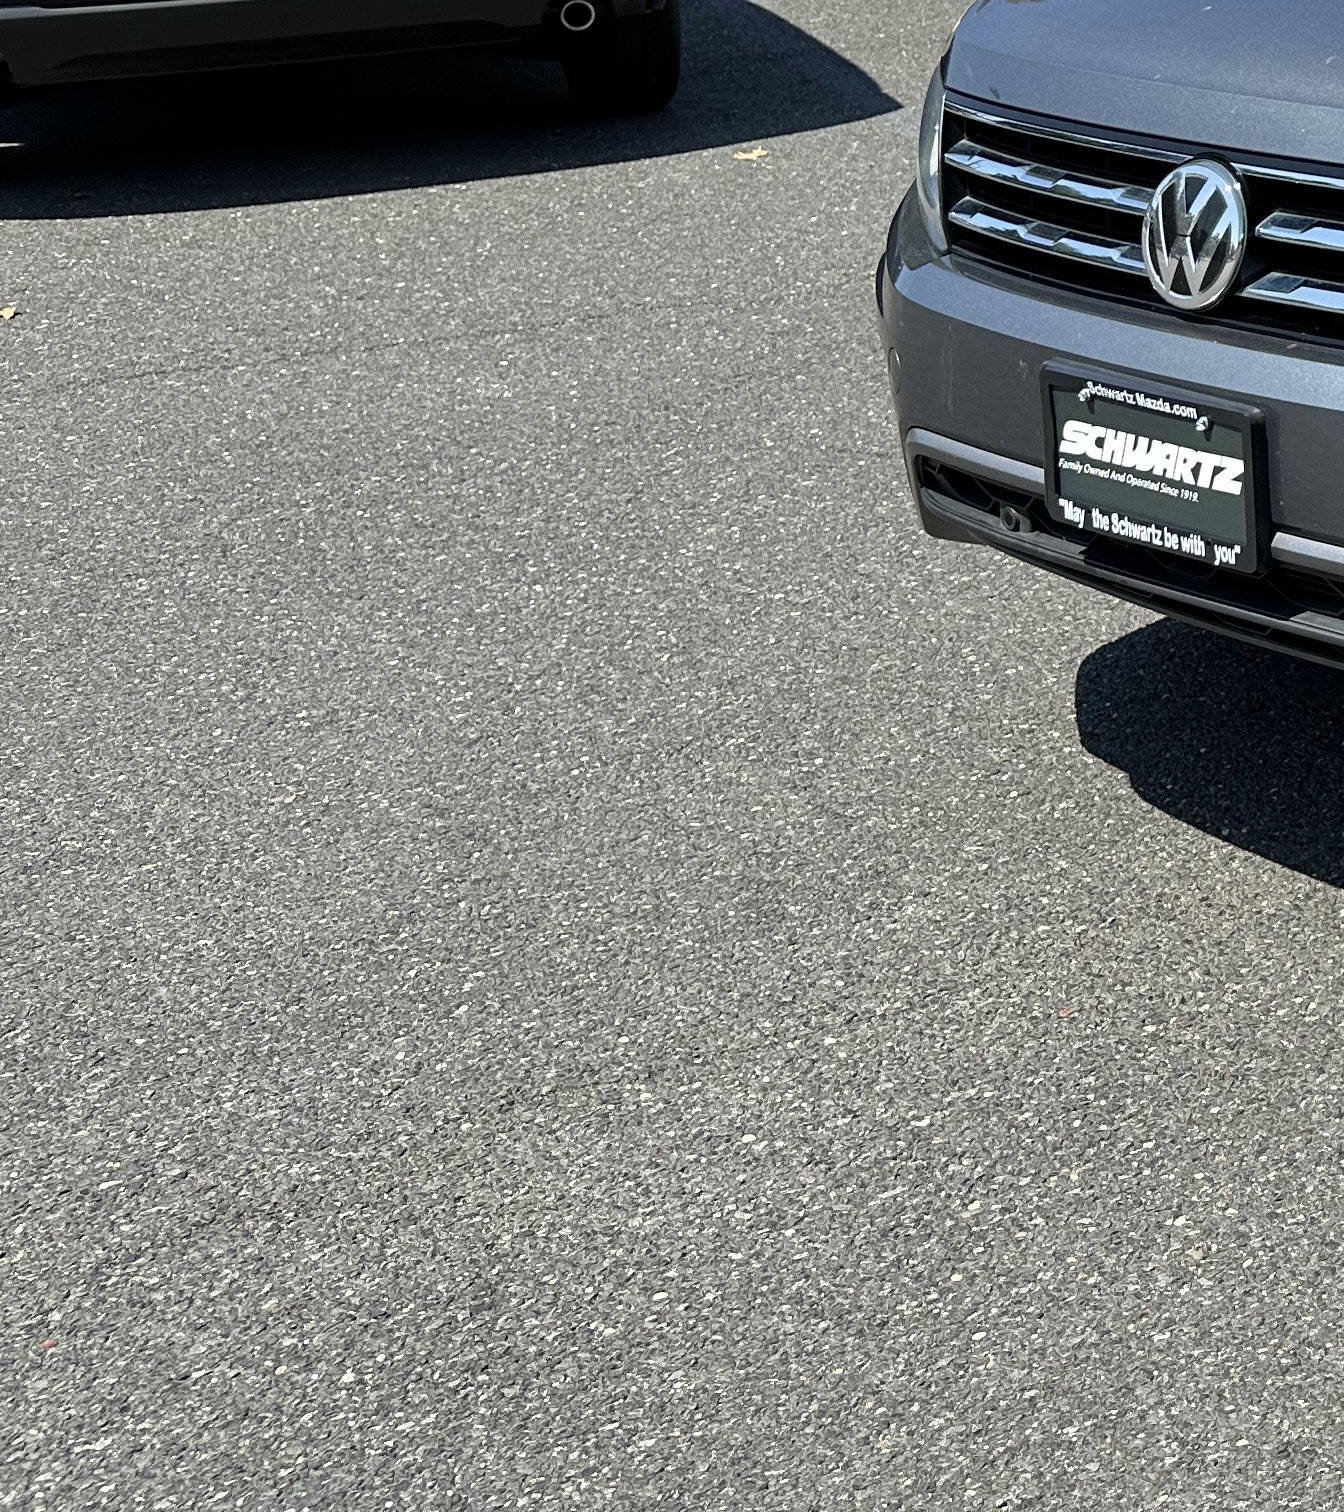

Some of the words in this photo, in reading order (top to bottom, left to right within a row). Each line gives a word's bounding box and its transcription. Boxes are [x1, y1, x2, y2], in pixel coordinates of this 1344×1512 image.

[1086, 381, 1136, 406] Schwartz
[1135, 393, 1198, 420] Mazda.com
[1058, 457, 1083, 474] Family
[1083, 463, 1110, 479] Owned
[1110, 469, 1126, 483] And
[1126, 473, 1160, 492] Operated
[1160, 482, 1179, 497] Since
[1059, 419, 1245, 495] SCHWARTZ
[1091, 507, 1110, 532] the
[1111, 512, 1163, 547] Schwartz
[1163, 526, 1179, 550] be
[1180, 533, 1206, 557] with
[1213, 544, 1241, 566] you"
